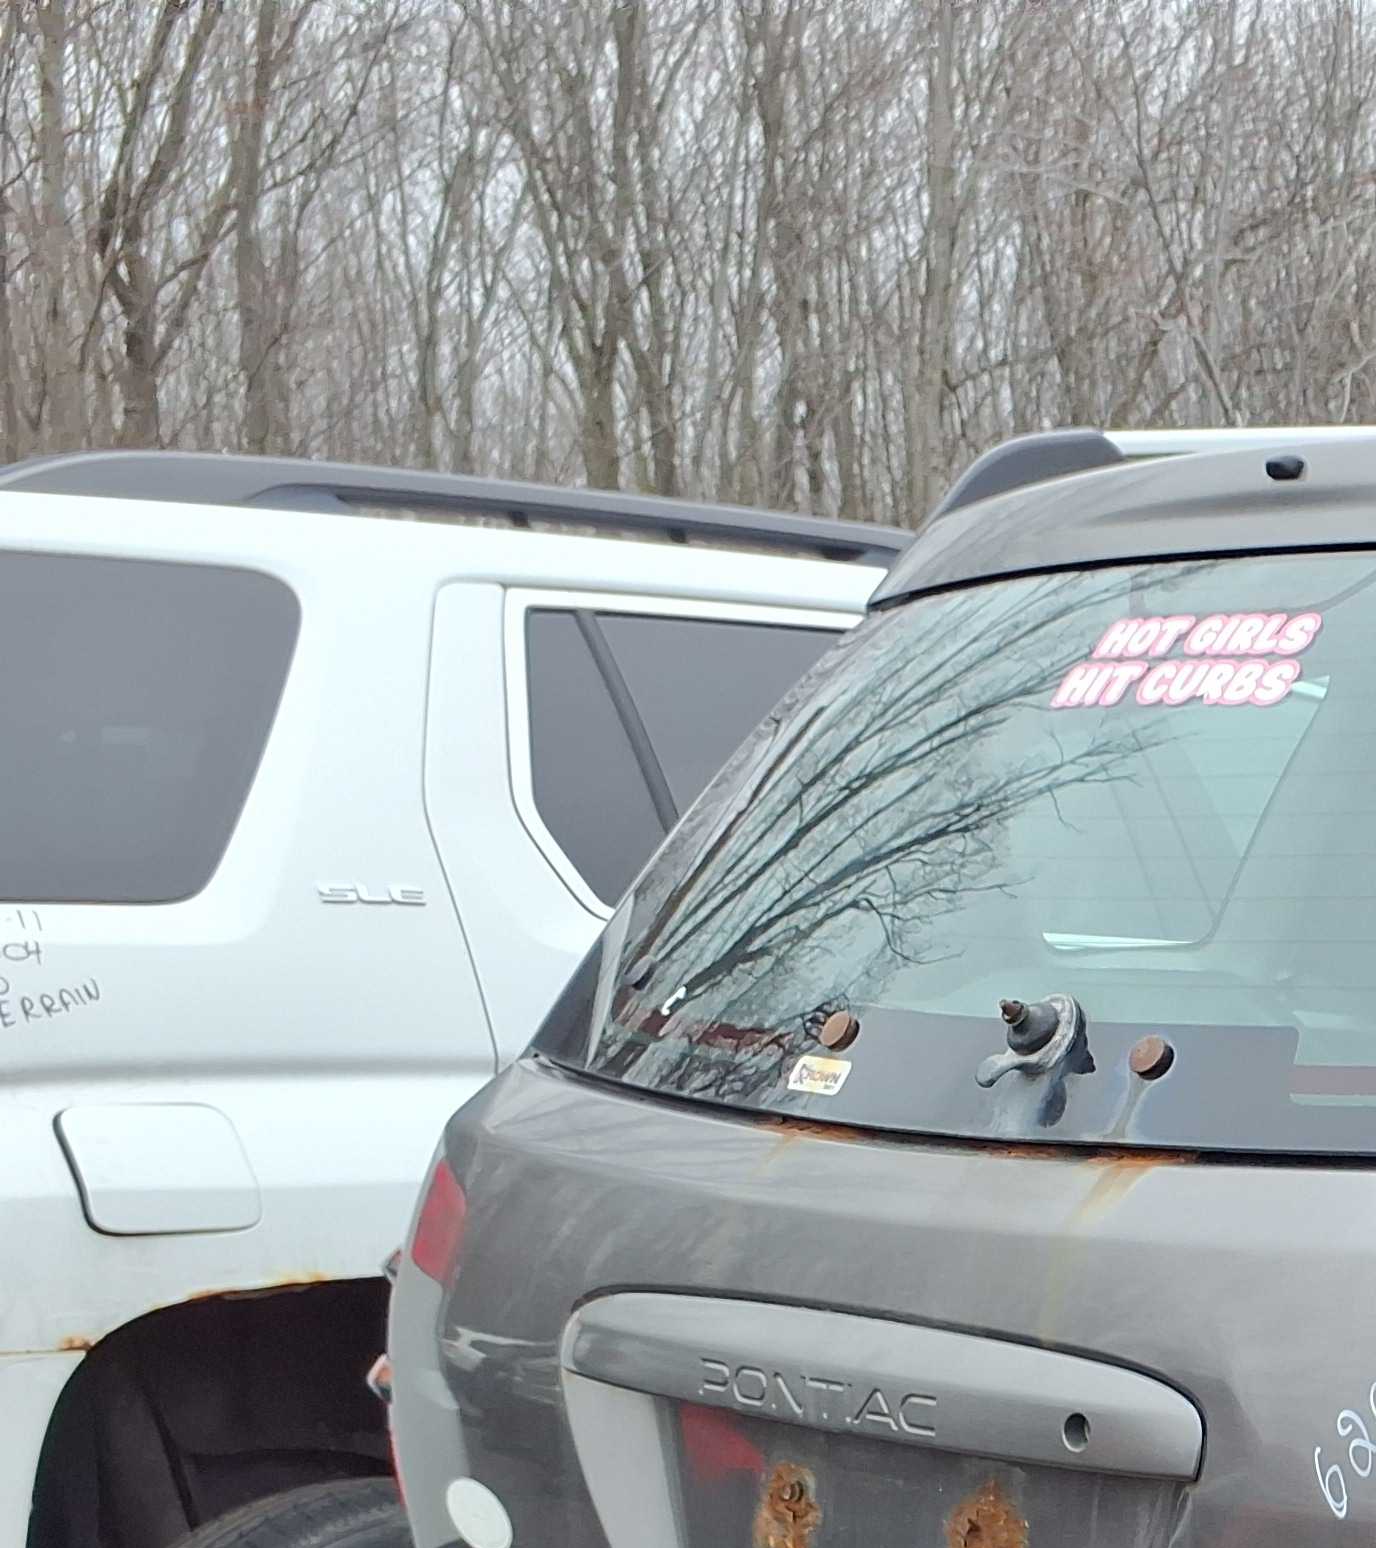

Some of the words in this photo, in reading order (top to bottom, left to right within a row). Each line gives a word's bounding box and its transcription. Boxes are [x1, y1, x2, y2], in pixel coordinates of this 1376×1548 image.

[1096, 615, 1195, 657] HOT
[1185, 612, 1321, 655] GIRLS
[1051, 662, 1147, 706] HIT
[1137, 659, 1300, 705] CURBS
[317, 882, 427, 906] SLE
[699, 1357, 937, 1437] PONTIAC
